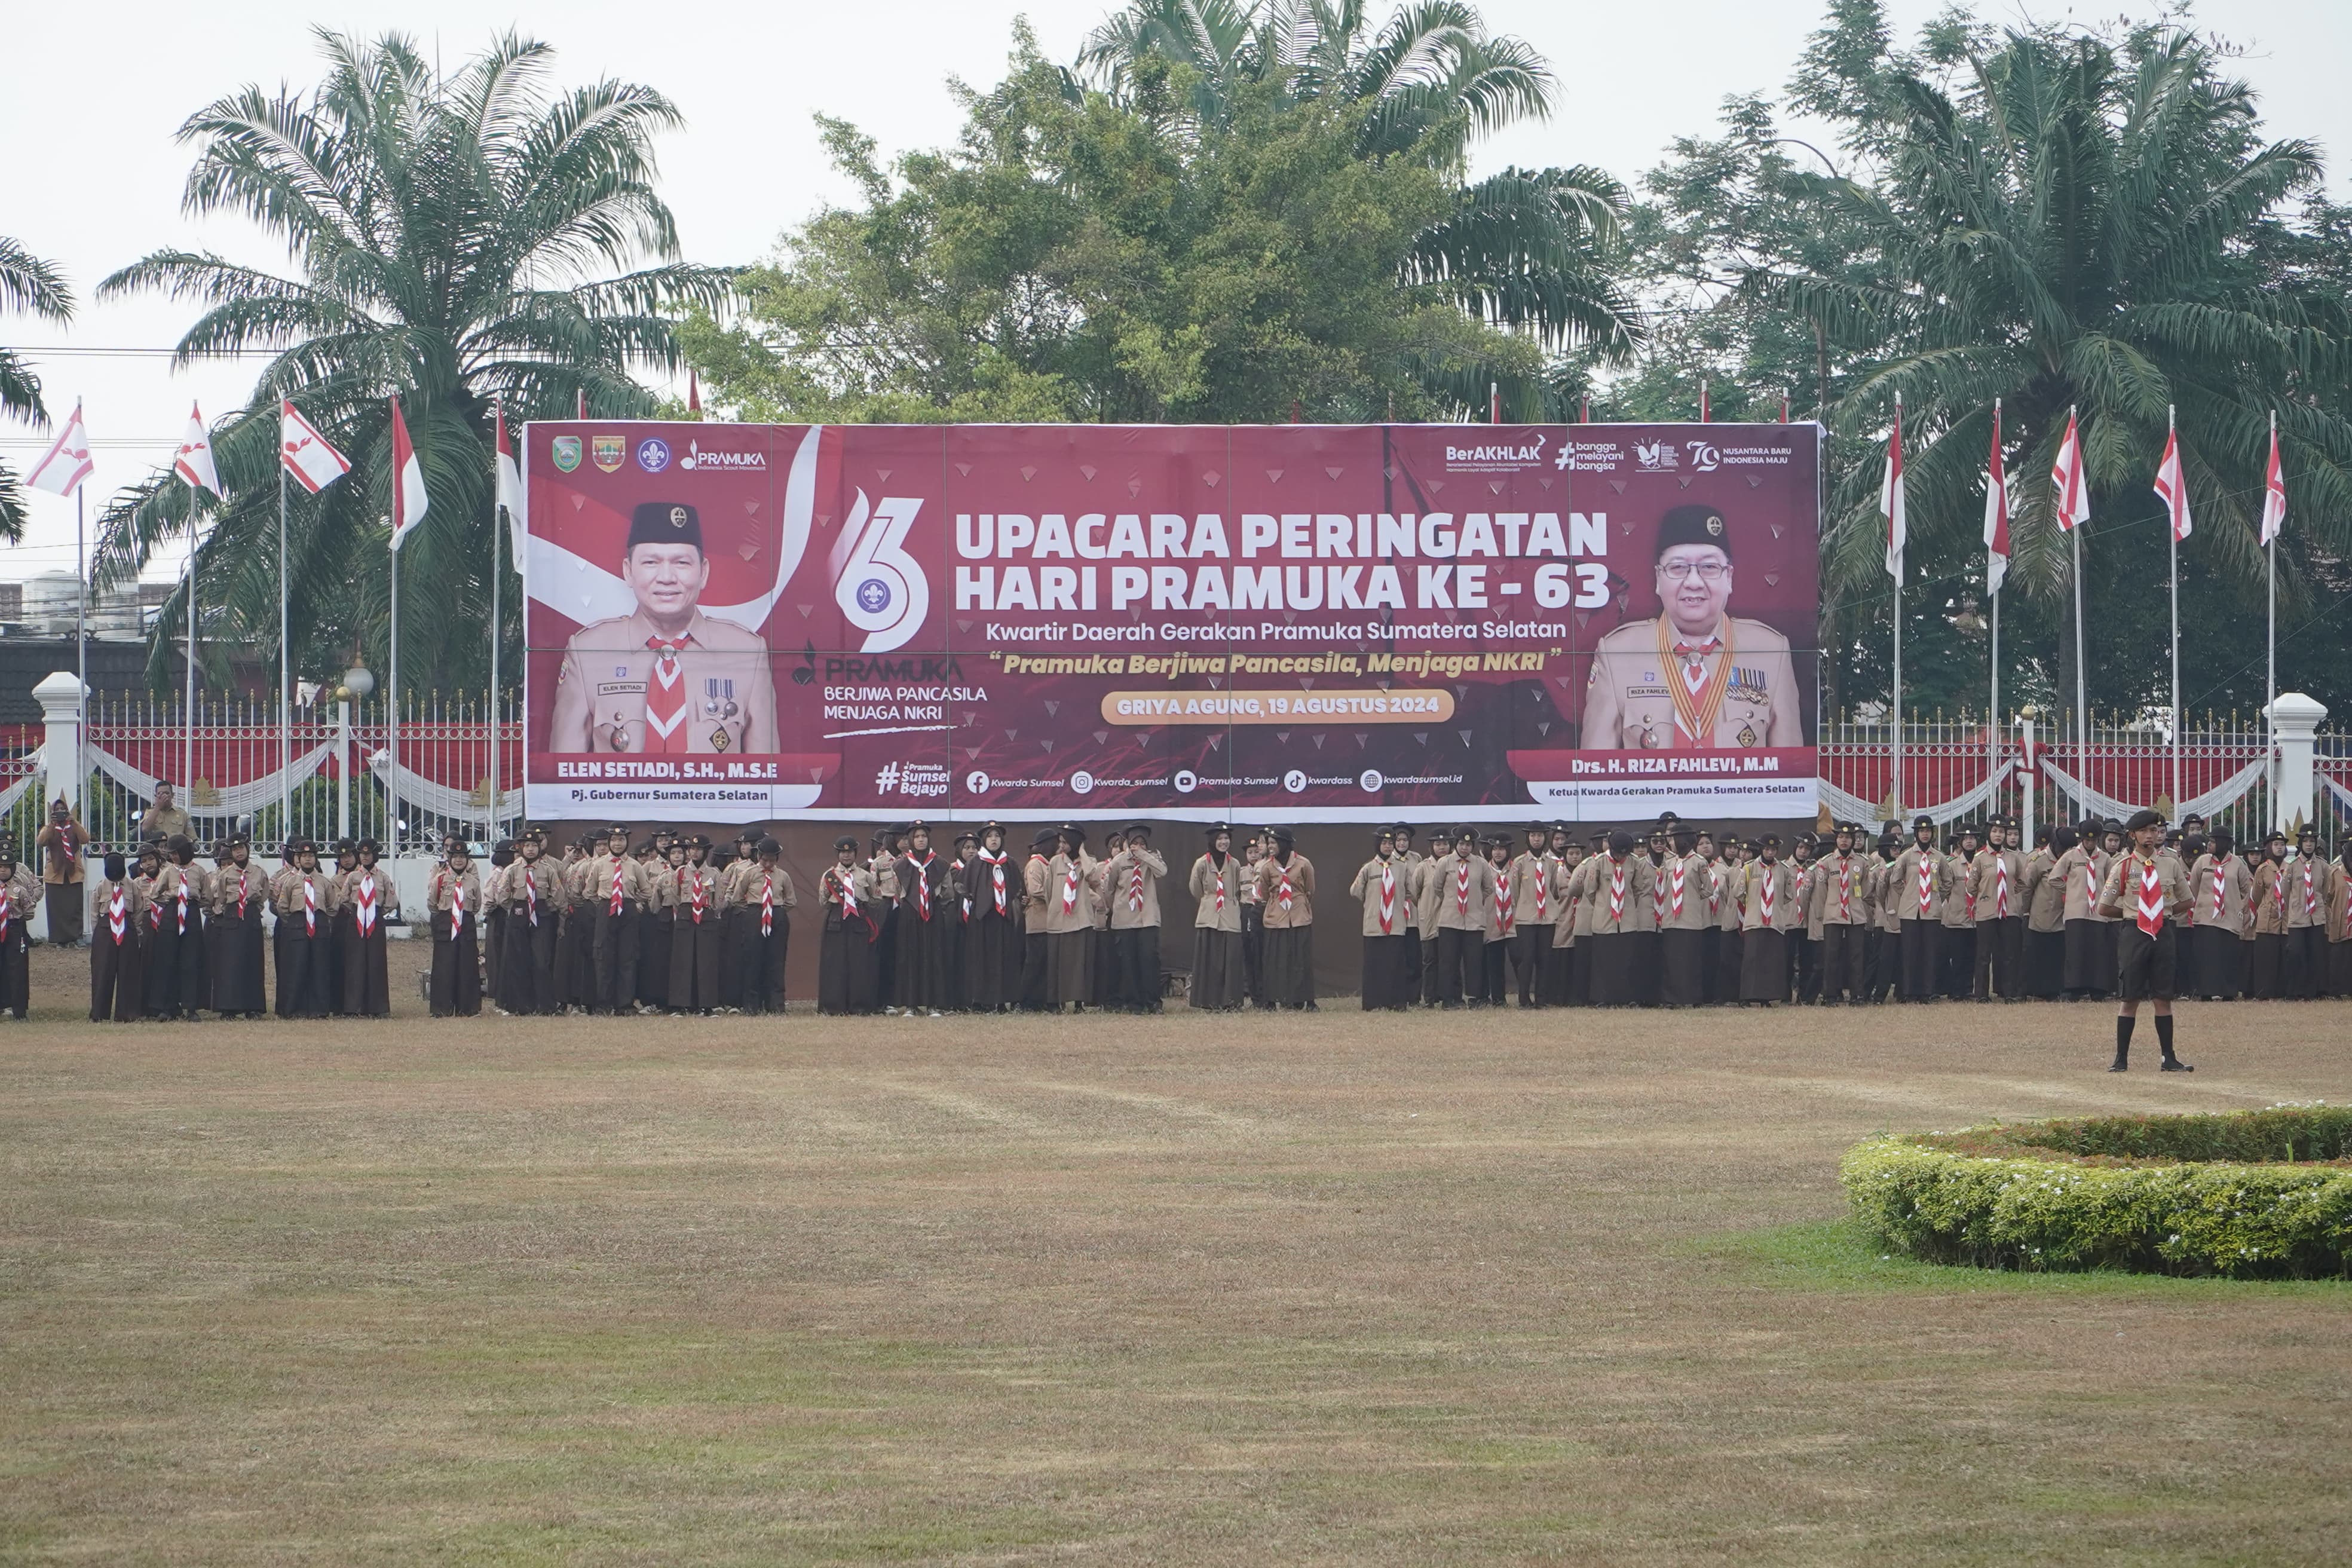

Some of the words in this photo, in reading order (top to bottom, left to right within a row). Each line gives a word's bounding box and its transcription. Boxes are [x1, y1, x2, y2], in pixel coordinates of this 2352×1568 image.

[1446, 446, 1541, 461] BerAKHLAK
[1576, 442, 1616, 452] bangga
[697, 452, 766, 465] PRAMUKA
[1576, 451, 1625, 463] melayani
[1686, 440, 1720, 472] 79
[1576, 461, 1616, 473] bangsa
[956, 513, 1230, 559] UPACARA
[1241, 512, 1607, 558] PERINGATAN
[956, 566, 1097, 610] HARI
[1111, 565, 1407, 611] PRAMUKA
[1417, 565, 1488, 609] KE
[1534, 563, 1610, 608] 63
[987, 621, 1068, 641] Kwartir
[1073, 623, 1155, 641] Daerah
[1160, 622, 1255, 641] Gerakan
[1261, 621, 1362, 640] Pramuka
[1367, 621, 1477, 639] Sumatera
[1483, 620, 1566, 638] Selatan
[825, 657, 965, 683] PRAMUKA
[1128, 651, 1226, 680] Berjiwa
[1230, 651, 1362, 678] Pancasila,
[1367, 650, 1480, 678] Menjaga
[824, 686, 893, 701] BERJIWA
[896, 687, 988, 701] PANCASILA
[824, 705, 901, 720] MENJAGA
[904, 706, 942, 720] NKRI
[1116, 698, 1181, 716] GRIYA
[1183, 695, 1266, 719] AGUNG,
[1267, 696, 1288, 716] 19
[1291, 695, 1388, 716] AGUSTUS
[1389, 695, 1440, 715] 2024
[558, 762, 602, 777] ELEN
[605, 761, 681, 780] SETIADI,
[683, 762, 725, 780] S.H.,
[727, 762, 777, 779] M.S.E
[1572, 759, 1606, 774] Drs.
[1608, 759, 1625, 773] H.
[1628, 758, 1667, 773] RIZA
[1670, 757, 1741, 774] FAHLEVI,
[1744, 757, 1779, 771] M.M
[901, 770, 951, 782] Sumsel
[991, 779, 1028, 787] Kwarda
[1029, 779, 1065, 787] Sumsel
[1094, 777, 1168, 787] Kwarda_sumsel
[1198, 777, 1242, 785] Pramuka
[1244, 776, 1278, 785] Sumsel
[1307, 776, 1353, 785] kwardass
[1383, 774, 1463, 784] kwardasumsel.id
[571, 789, 588, 802] Pj.
[590, 789, 651, 800] Gubernur
[653, 790, 716, 800] Sumatera
[718, 790, 768, 801] Selatan
[900, 782, 948, 797] Bejayo
[1549, 788, 1579, 797] Ketua
[1581, 788, 1620, 796] Kwarda
[1621, 786, 1665, 796] Gerakan
[1667, 786, 1712, 795] Pramuka
[1714, 786, 1764, 794] Sumatera
[1765, 785, 1805, 794] Selatan
